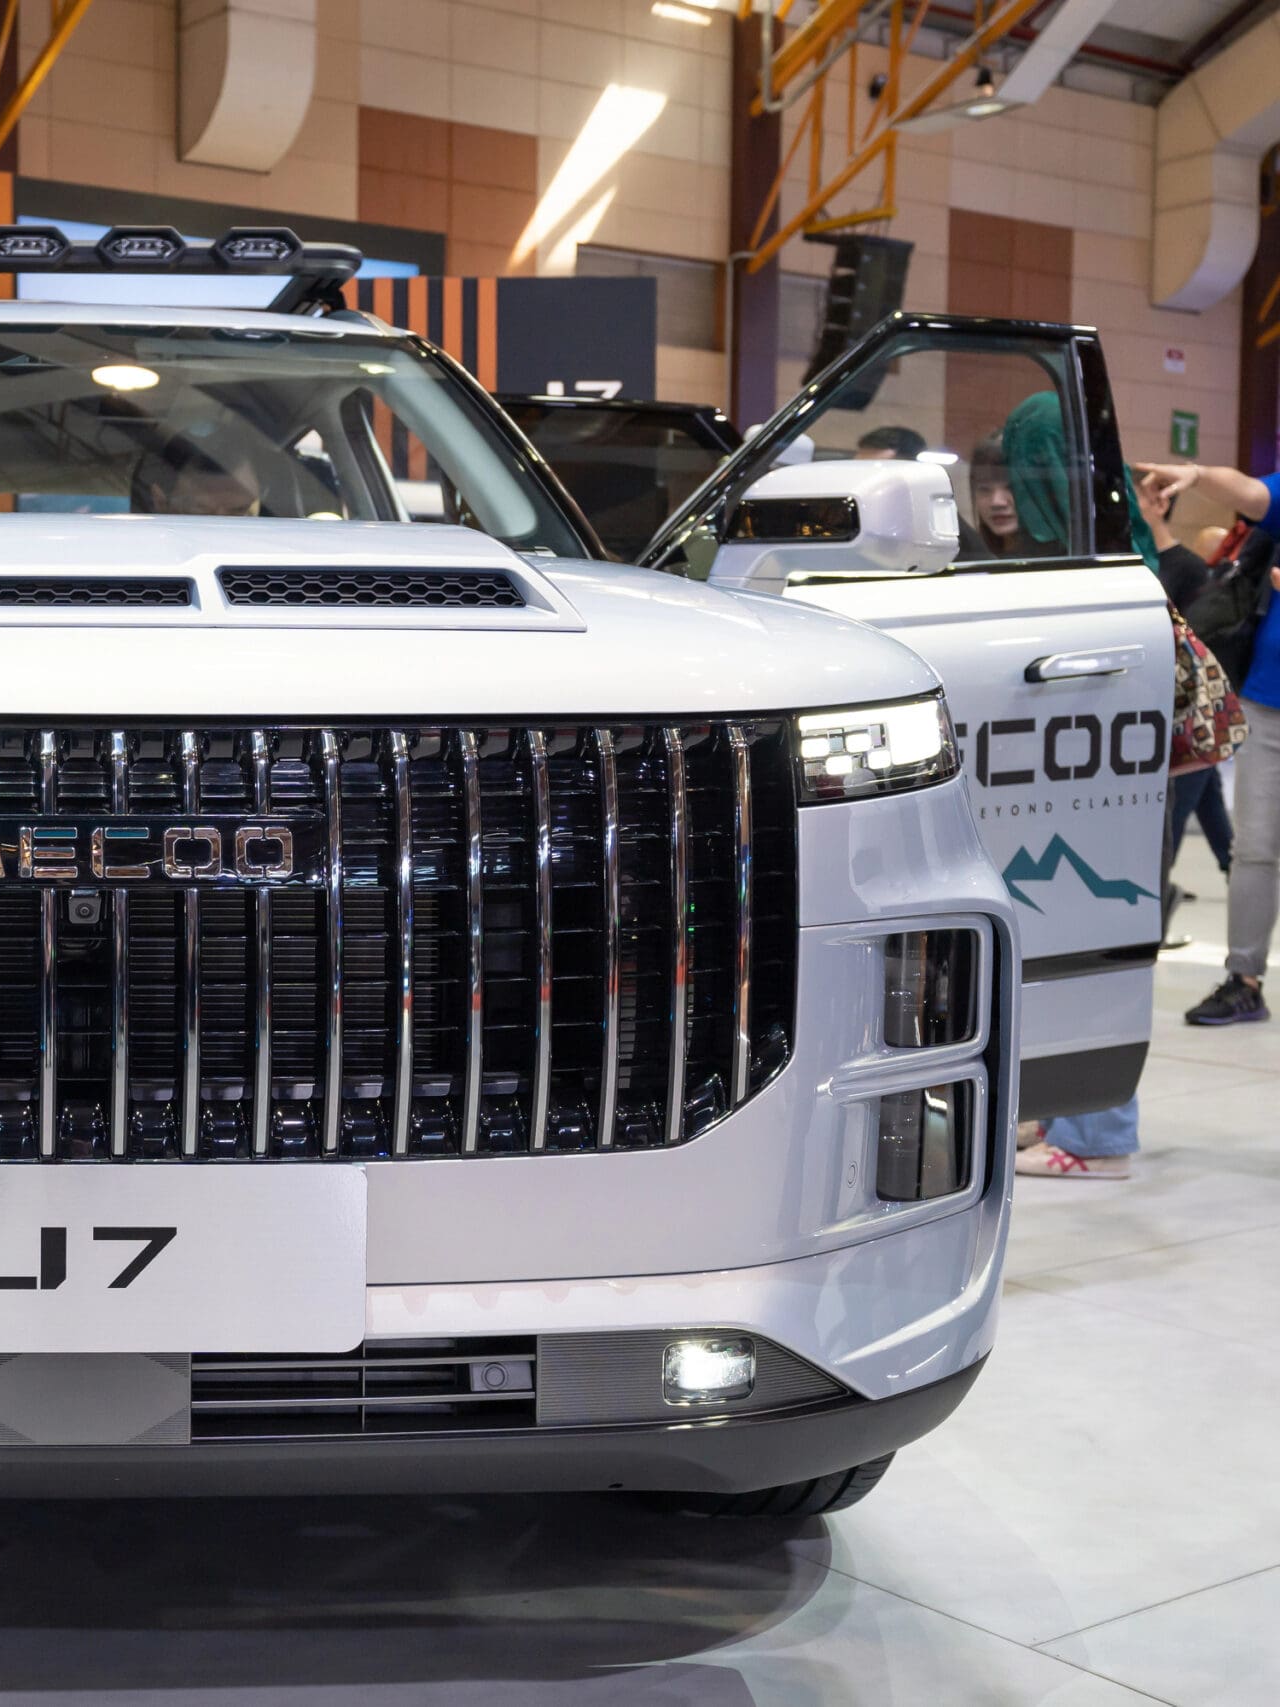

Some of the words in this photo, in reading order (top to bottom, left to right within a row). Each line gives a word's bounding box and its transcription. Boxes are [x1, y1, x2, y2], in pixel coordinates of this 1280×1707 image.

[954, 709, 1167, 788] COO
[979, 801, 1054, 820] EYOND
[1072, 791, 1165, 810] CLASSIC
